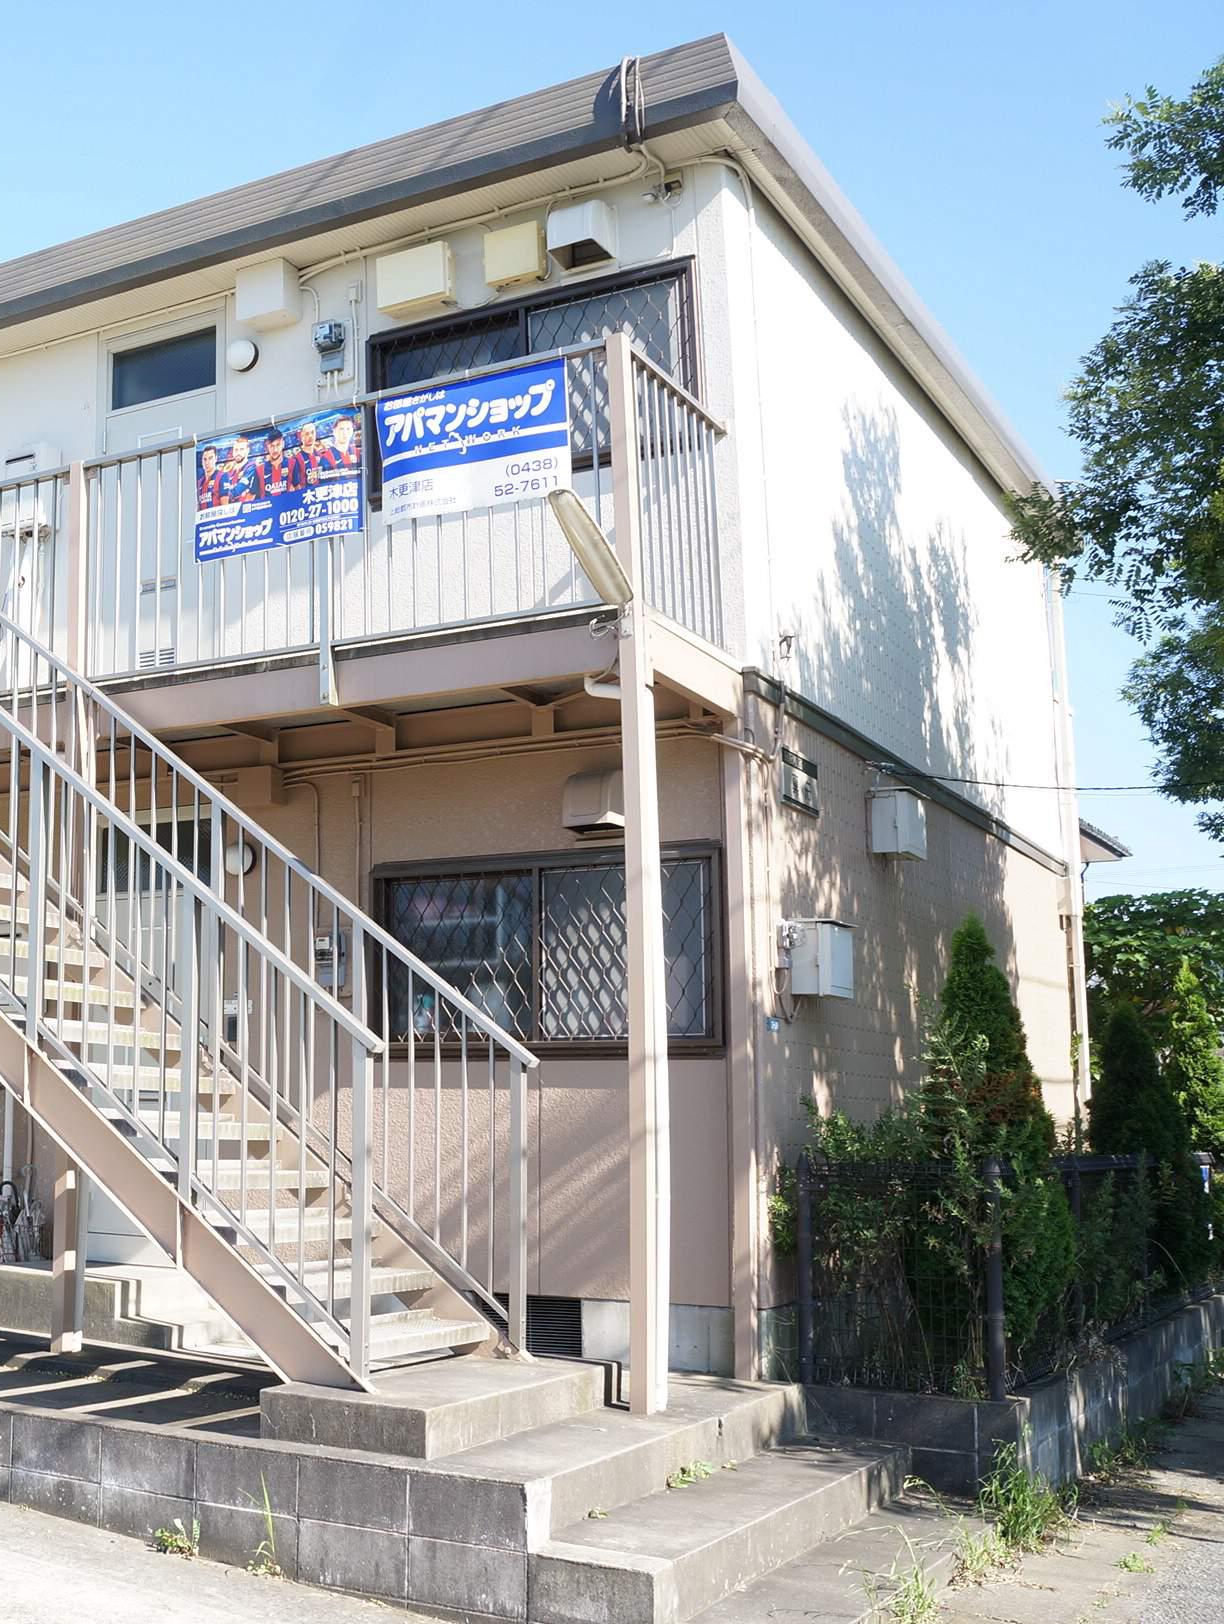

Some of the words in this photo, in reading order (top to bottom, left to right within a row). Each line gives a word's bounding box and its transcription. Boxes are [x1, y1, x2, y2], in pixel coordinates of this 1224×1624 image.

[384, 378, 556, 447] アパマンショップ
[505, 457, 558, 477] (0438)
[302, 482, 359, 505] 木更津店
[389, 478, 434, 500] 木更津店
[494, 476, 559, 498] 52-7611
[279, 498, 359, 526] 0120-27-1000
[199, 517, 273, 548] アパマンショップ
[315, 518, 353, 535] 059821
